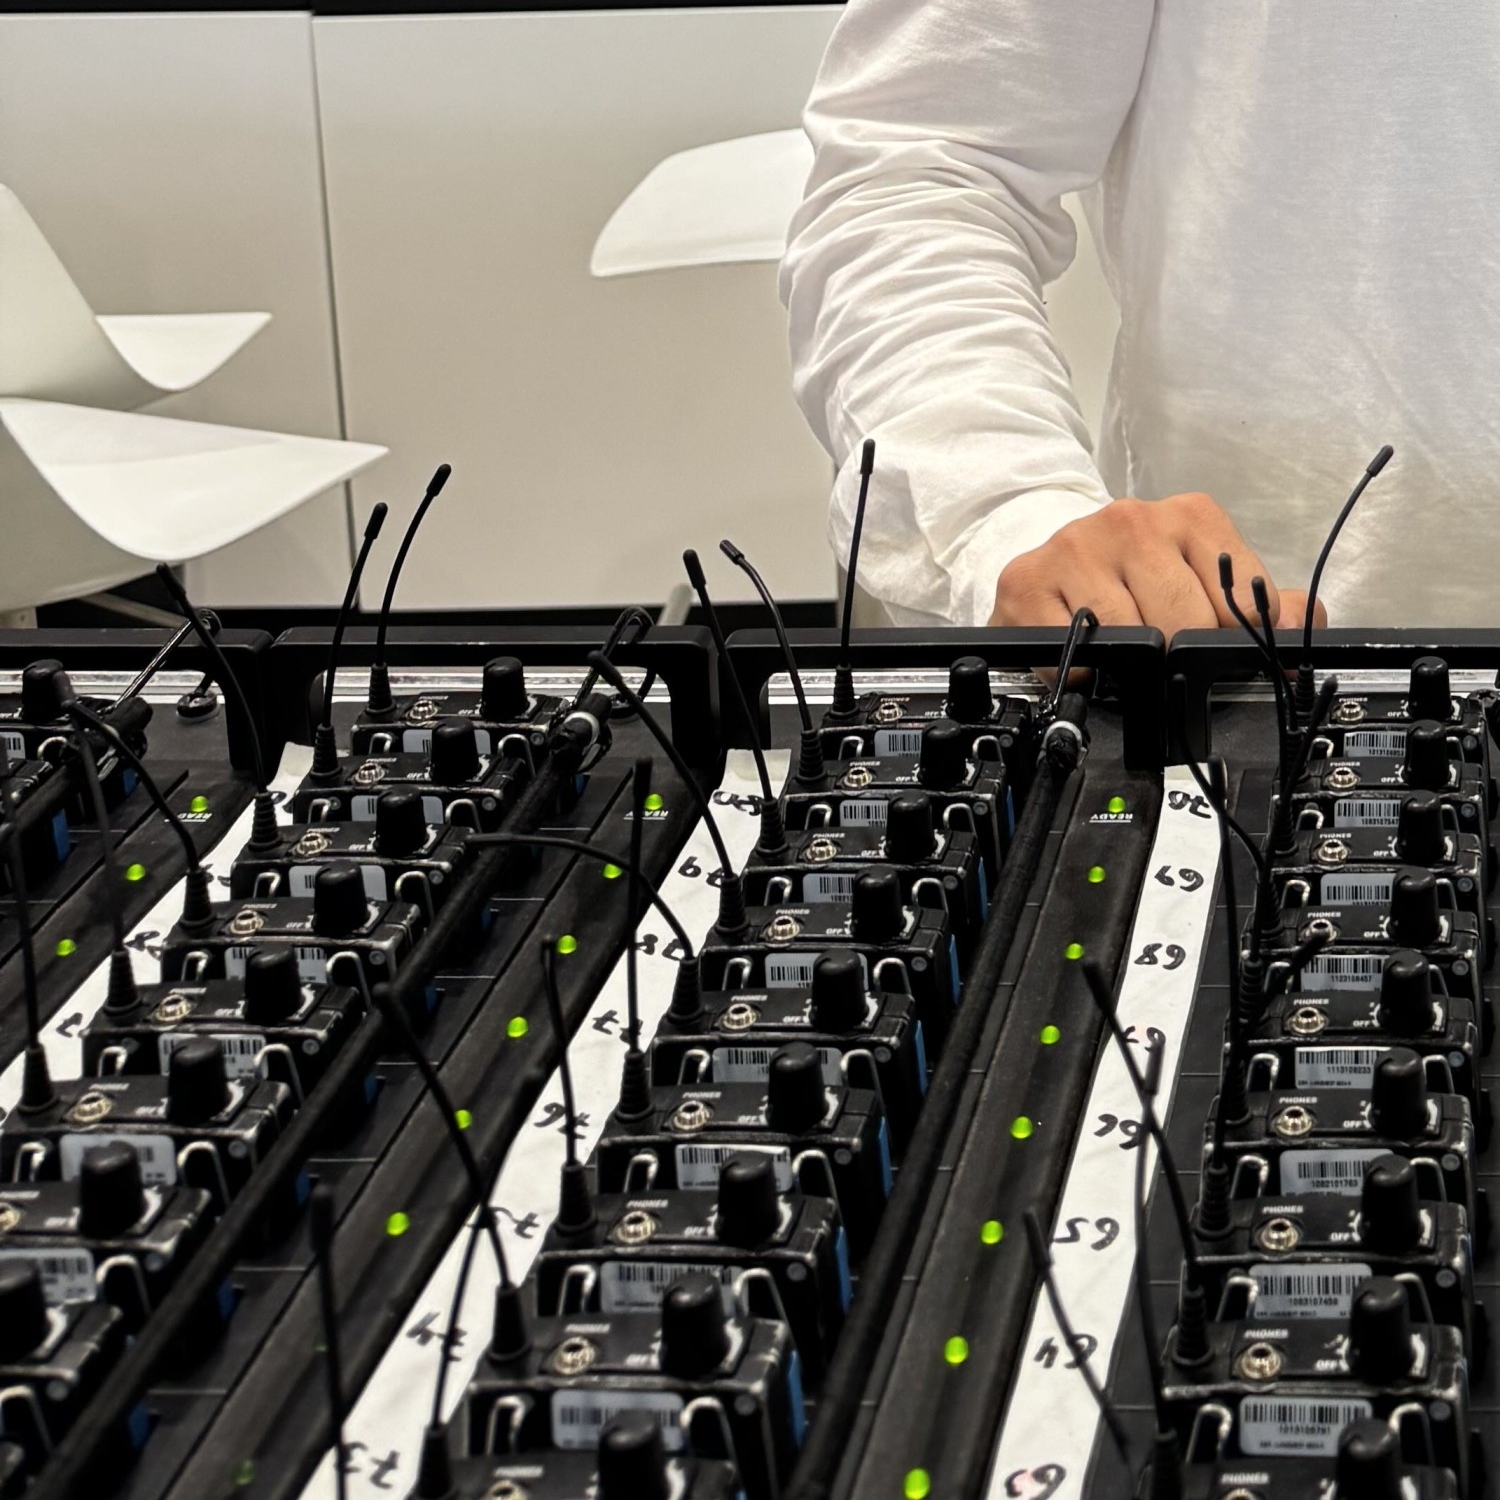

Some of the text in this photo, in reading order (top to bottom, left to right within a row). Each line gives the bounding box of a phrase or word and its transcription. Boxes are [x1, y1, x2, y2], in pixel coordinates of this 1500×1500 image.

[1168, 788, 1212, 819] 70
[176, 812, 213, 820] READ
[624, 810, 670, 818] REAY
[1090, 812, 1134, 820] READY
[1154, 866, 1204, 893] 69
[1134, 942, 1188, 971] 68
[1094, 1113, 1148, 1150] 66
[1262, 1205, 1304, 1214] PHONES
[1052, 1216, 1121, 1251] 65
[1243, 1328, 1290, 1339] PHONES
